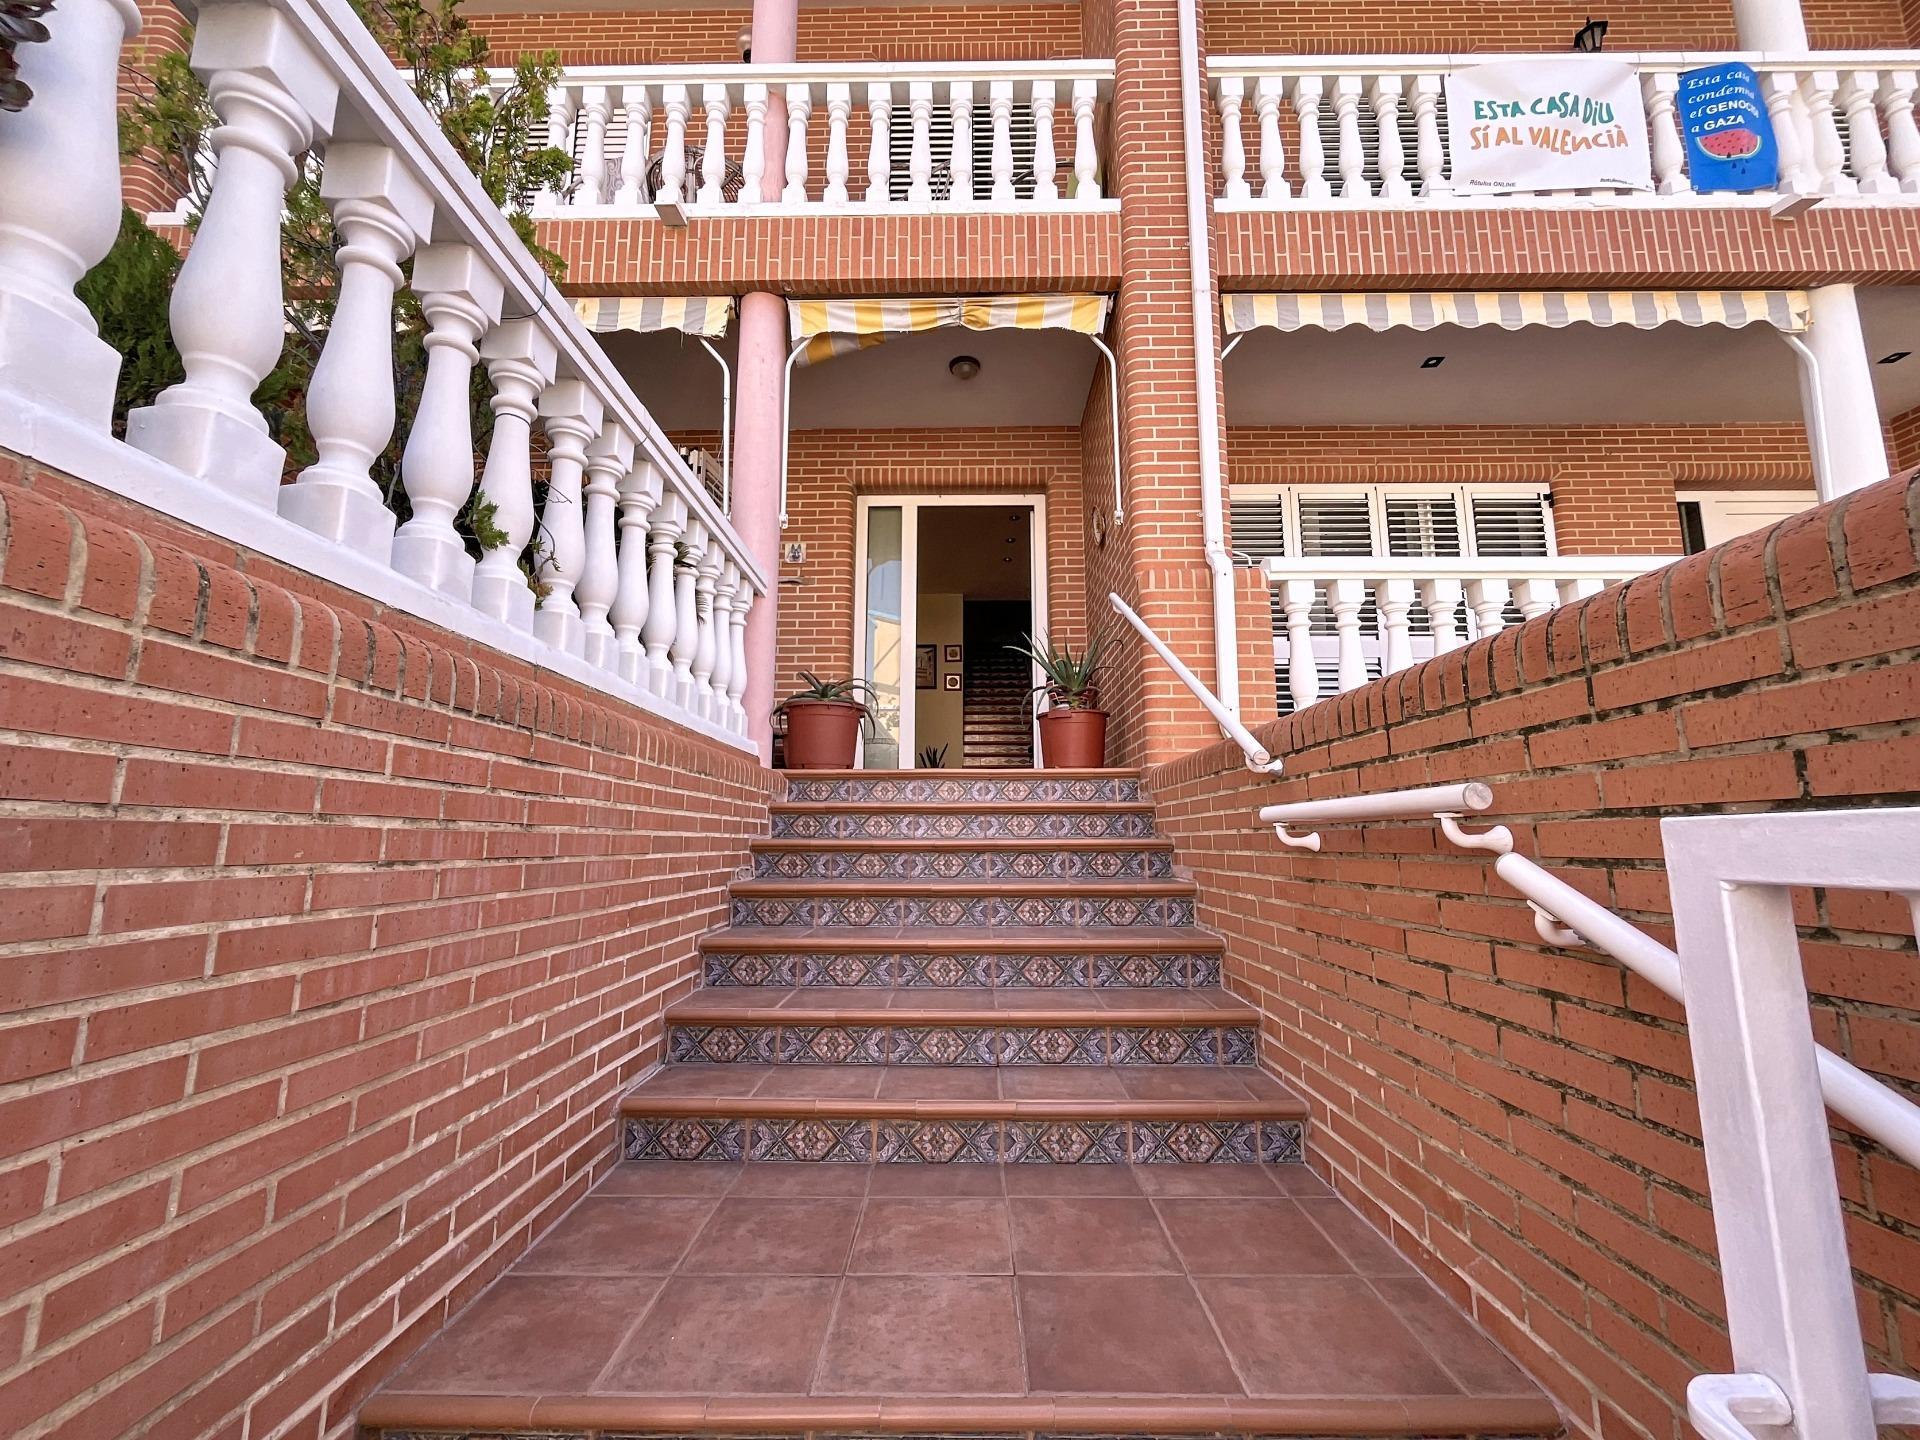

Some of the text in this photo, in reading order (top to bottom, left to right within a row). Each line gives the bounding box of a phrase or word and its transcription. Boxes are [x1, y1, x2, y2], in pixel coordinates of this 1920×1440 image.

[1687, 74, 1721, 90] Esta
[1474, 100, 1526, 120] ESTA
[1530, 92, 1580, 119] CASA
[1689, 105, 1706, 119] el
[1691, 114, 1745, 133] a GAZA
[1495, 126, 1523, 146] AL
